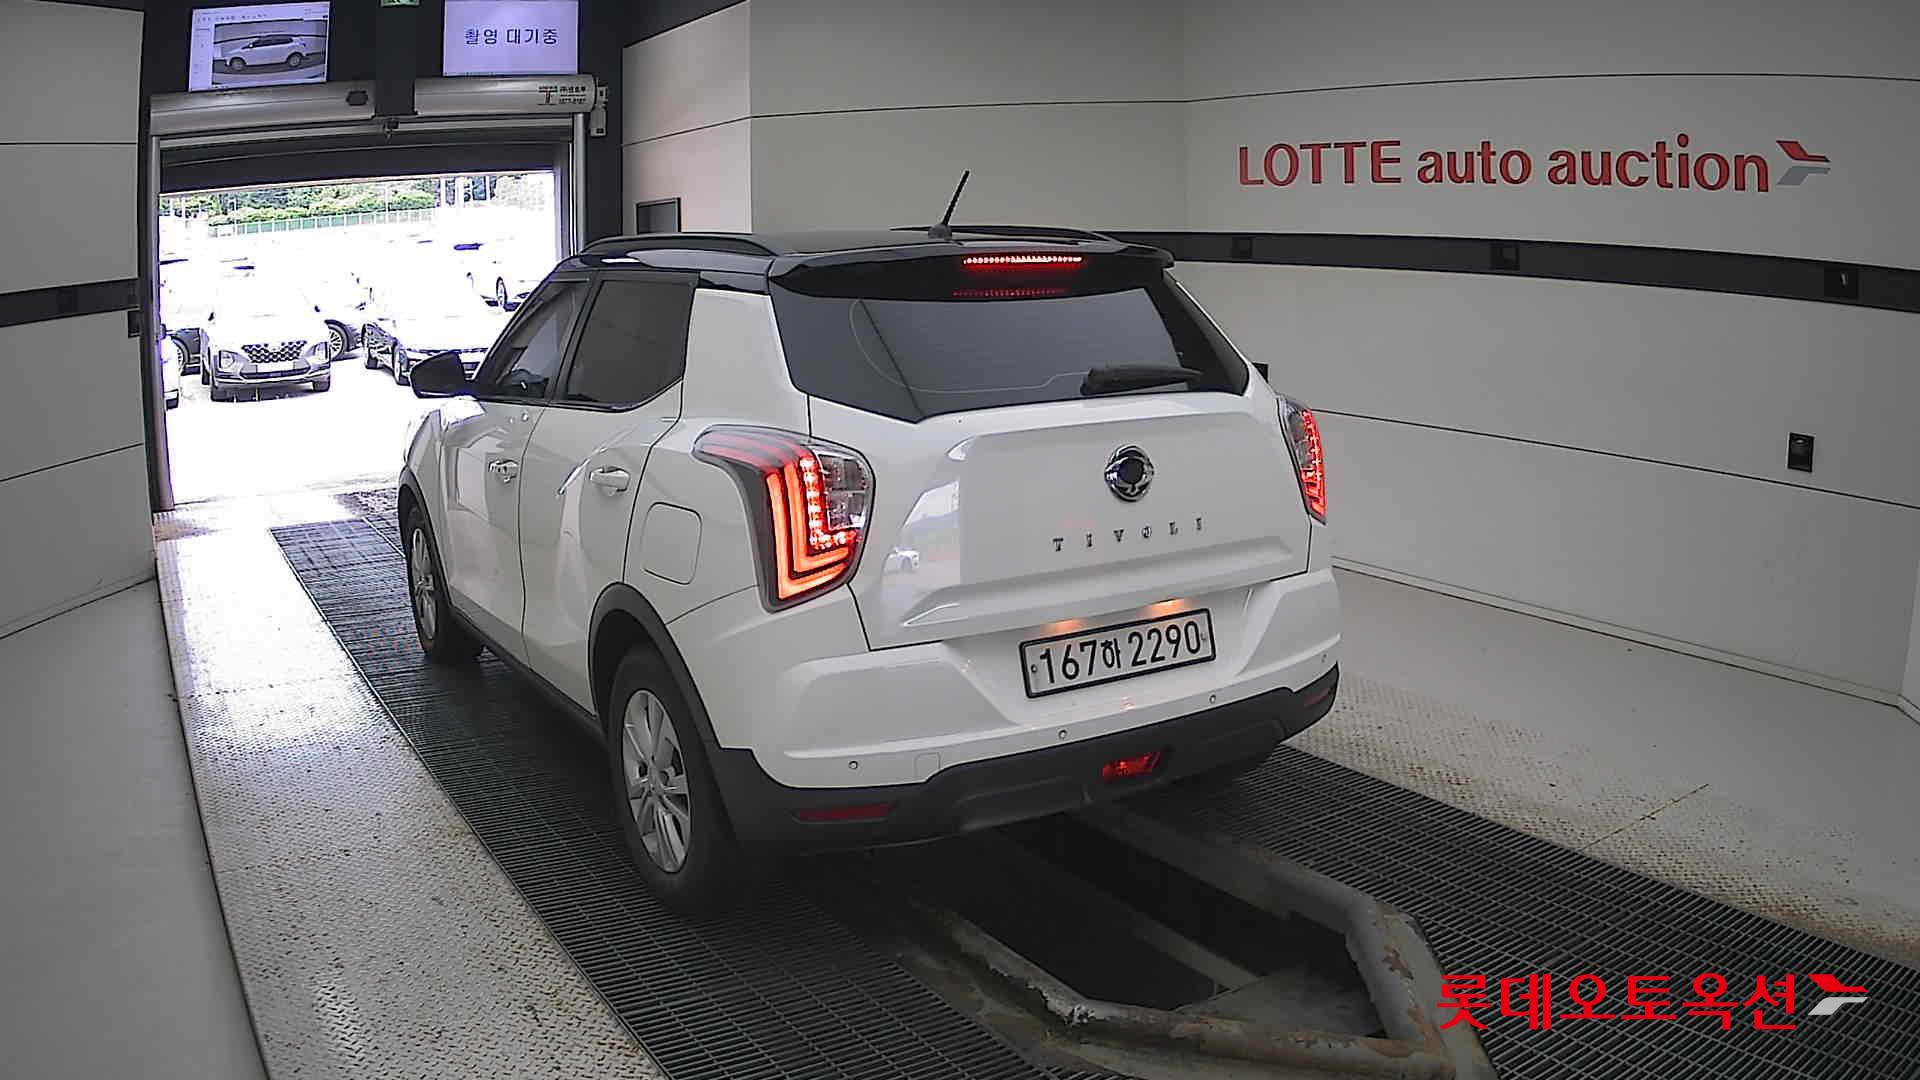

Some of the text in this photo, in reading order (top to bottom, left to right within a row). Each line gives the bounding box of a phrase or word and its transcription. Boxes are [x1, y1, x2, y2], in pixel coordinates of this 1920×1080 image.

[465, 28, 559, 45] 촬영 대기중
[1239, 132, 1770, 192] LOTTE auto auction
[1052, 516, 1203, 552] TIVOLI
[1039, 620, 1202, 684] 167하 2290
